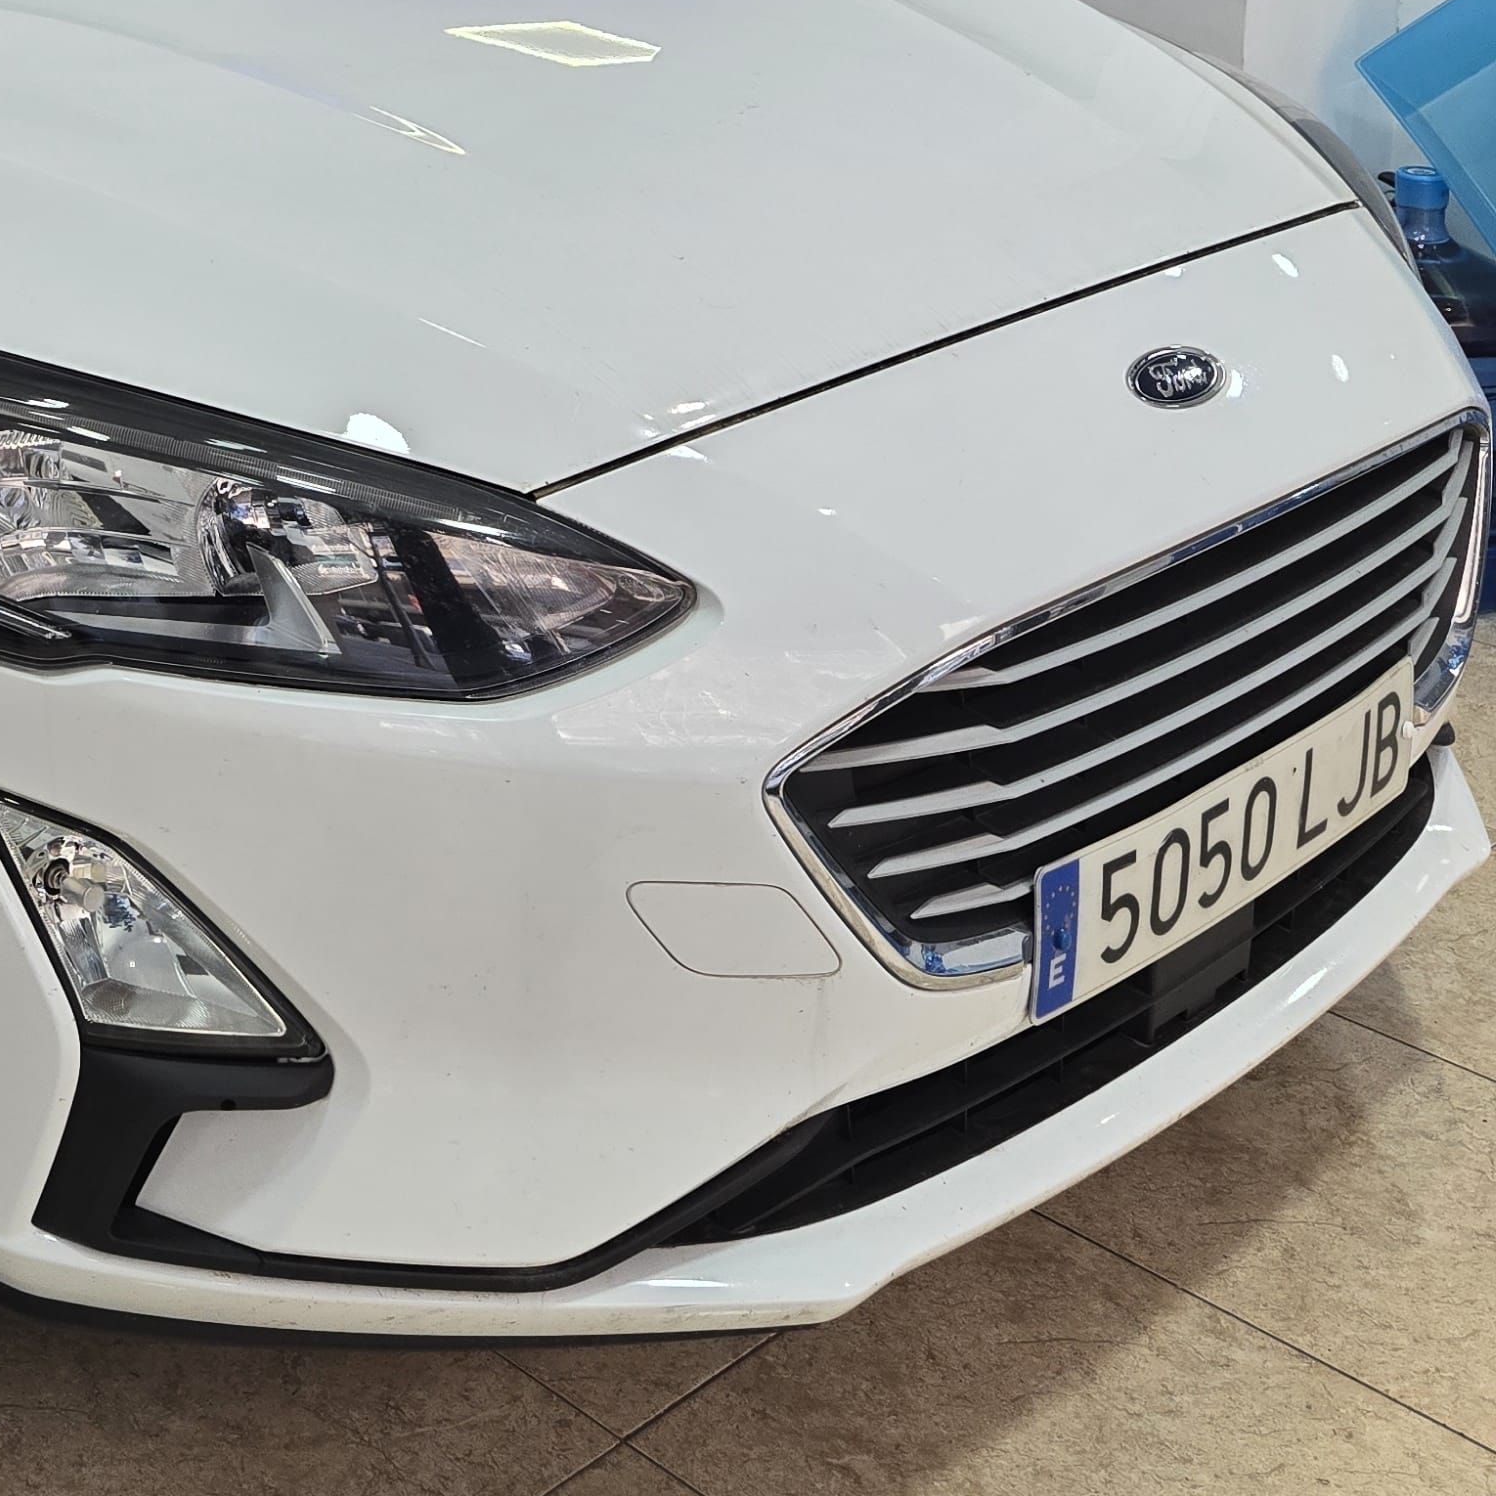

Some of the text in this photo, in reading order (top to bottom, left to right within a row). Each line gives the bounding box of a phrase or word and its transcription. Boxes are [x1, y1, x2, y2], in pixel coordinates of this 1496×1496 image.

[1101, 691, 1401, 964] 5050 LJB
[1048, 953, 1067, 989] E
